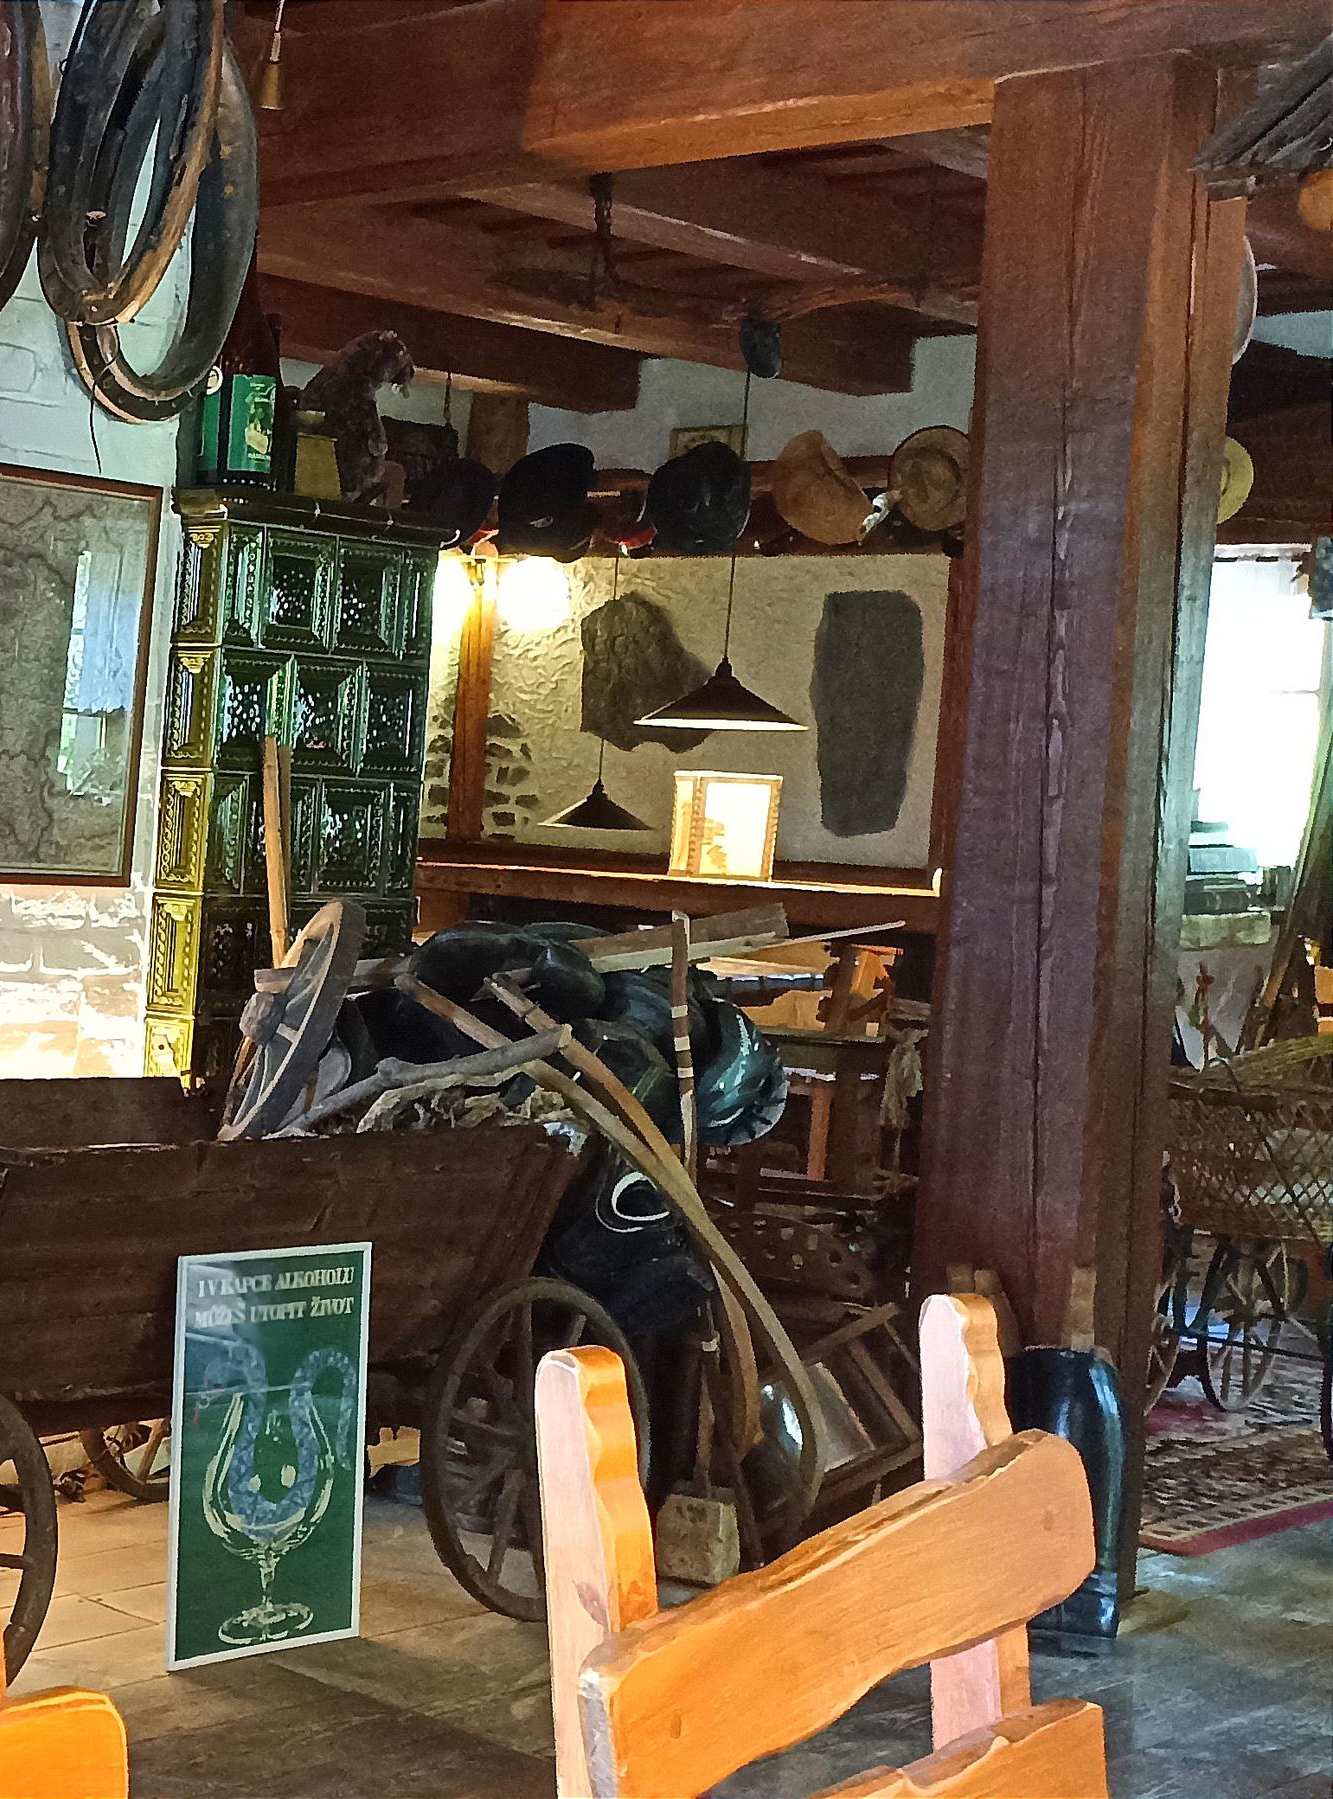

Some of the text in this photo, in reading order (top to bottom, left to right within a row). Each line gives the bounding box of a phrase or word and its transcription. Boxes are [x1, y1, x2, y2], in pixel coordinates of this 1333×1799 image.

[198, 1280, 205, 1298] I
[208, 1279, 218, 1297] V
[274, 1267, 355, 1290] ALKOHOLU
[250, 1301, 307, 1323] UTOPIT
[310, 1296, 355, 1317] ŽIVOT
